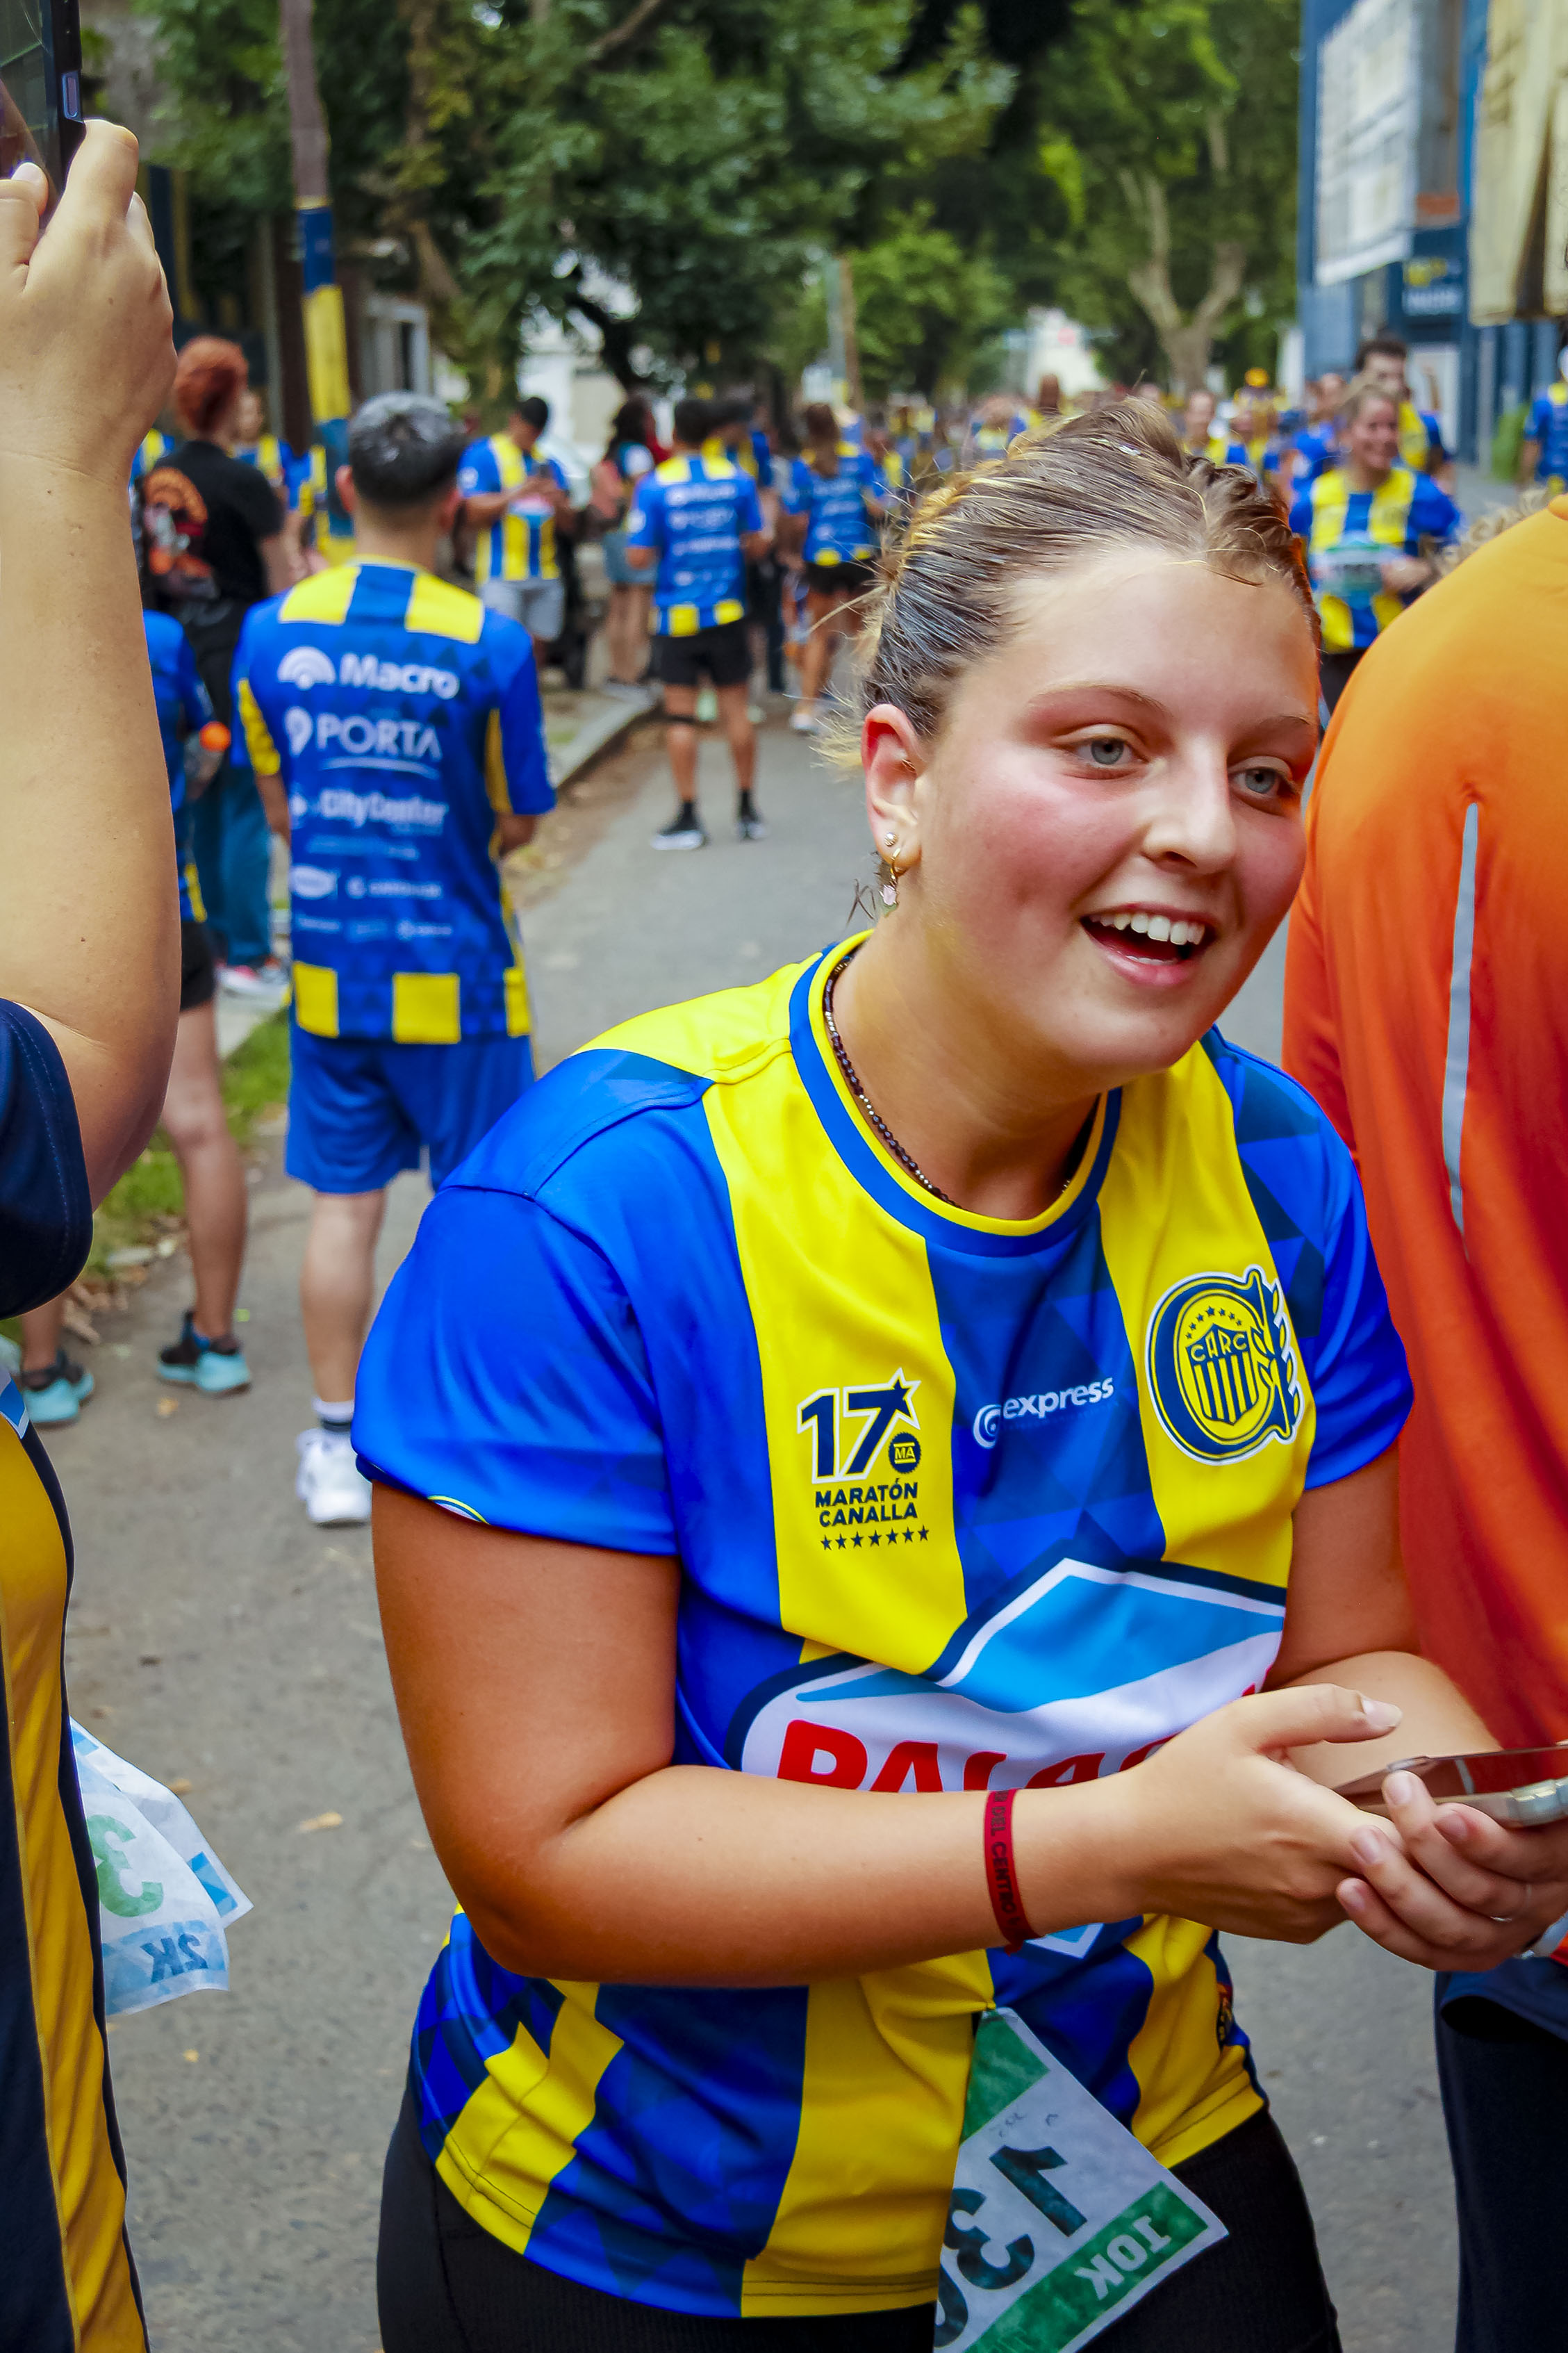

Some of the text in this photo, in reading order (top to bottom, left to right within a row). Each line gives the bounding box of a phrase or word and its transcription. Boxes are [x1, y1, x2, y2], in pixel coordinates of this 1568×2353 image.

[339, 652, 460, 700] Macro
[316, 712, 443, 761] PORTA
[1190, 1329, 1247, 1362] CARC
[1002, 1377, 1114, 1419] express
[798, 1379, 917, 1484] 17
[894, 1446, 916, 1460] MA
[815, 1478, 918, 1508] MARATÓN
[819, 1502, 918, 1527] CANALLA
